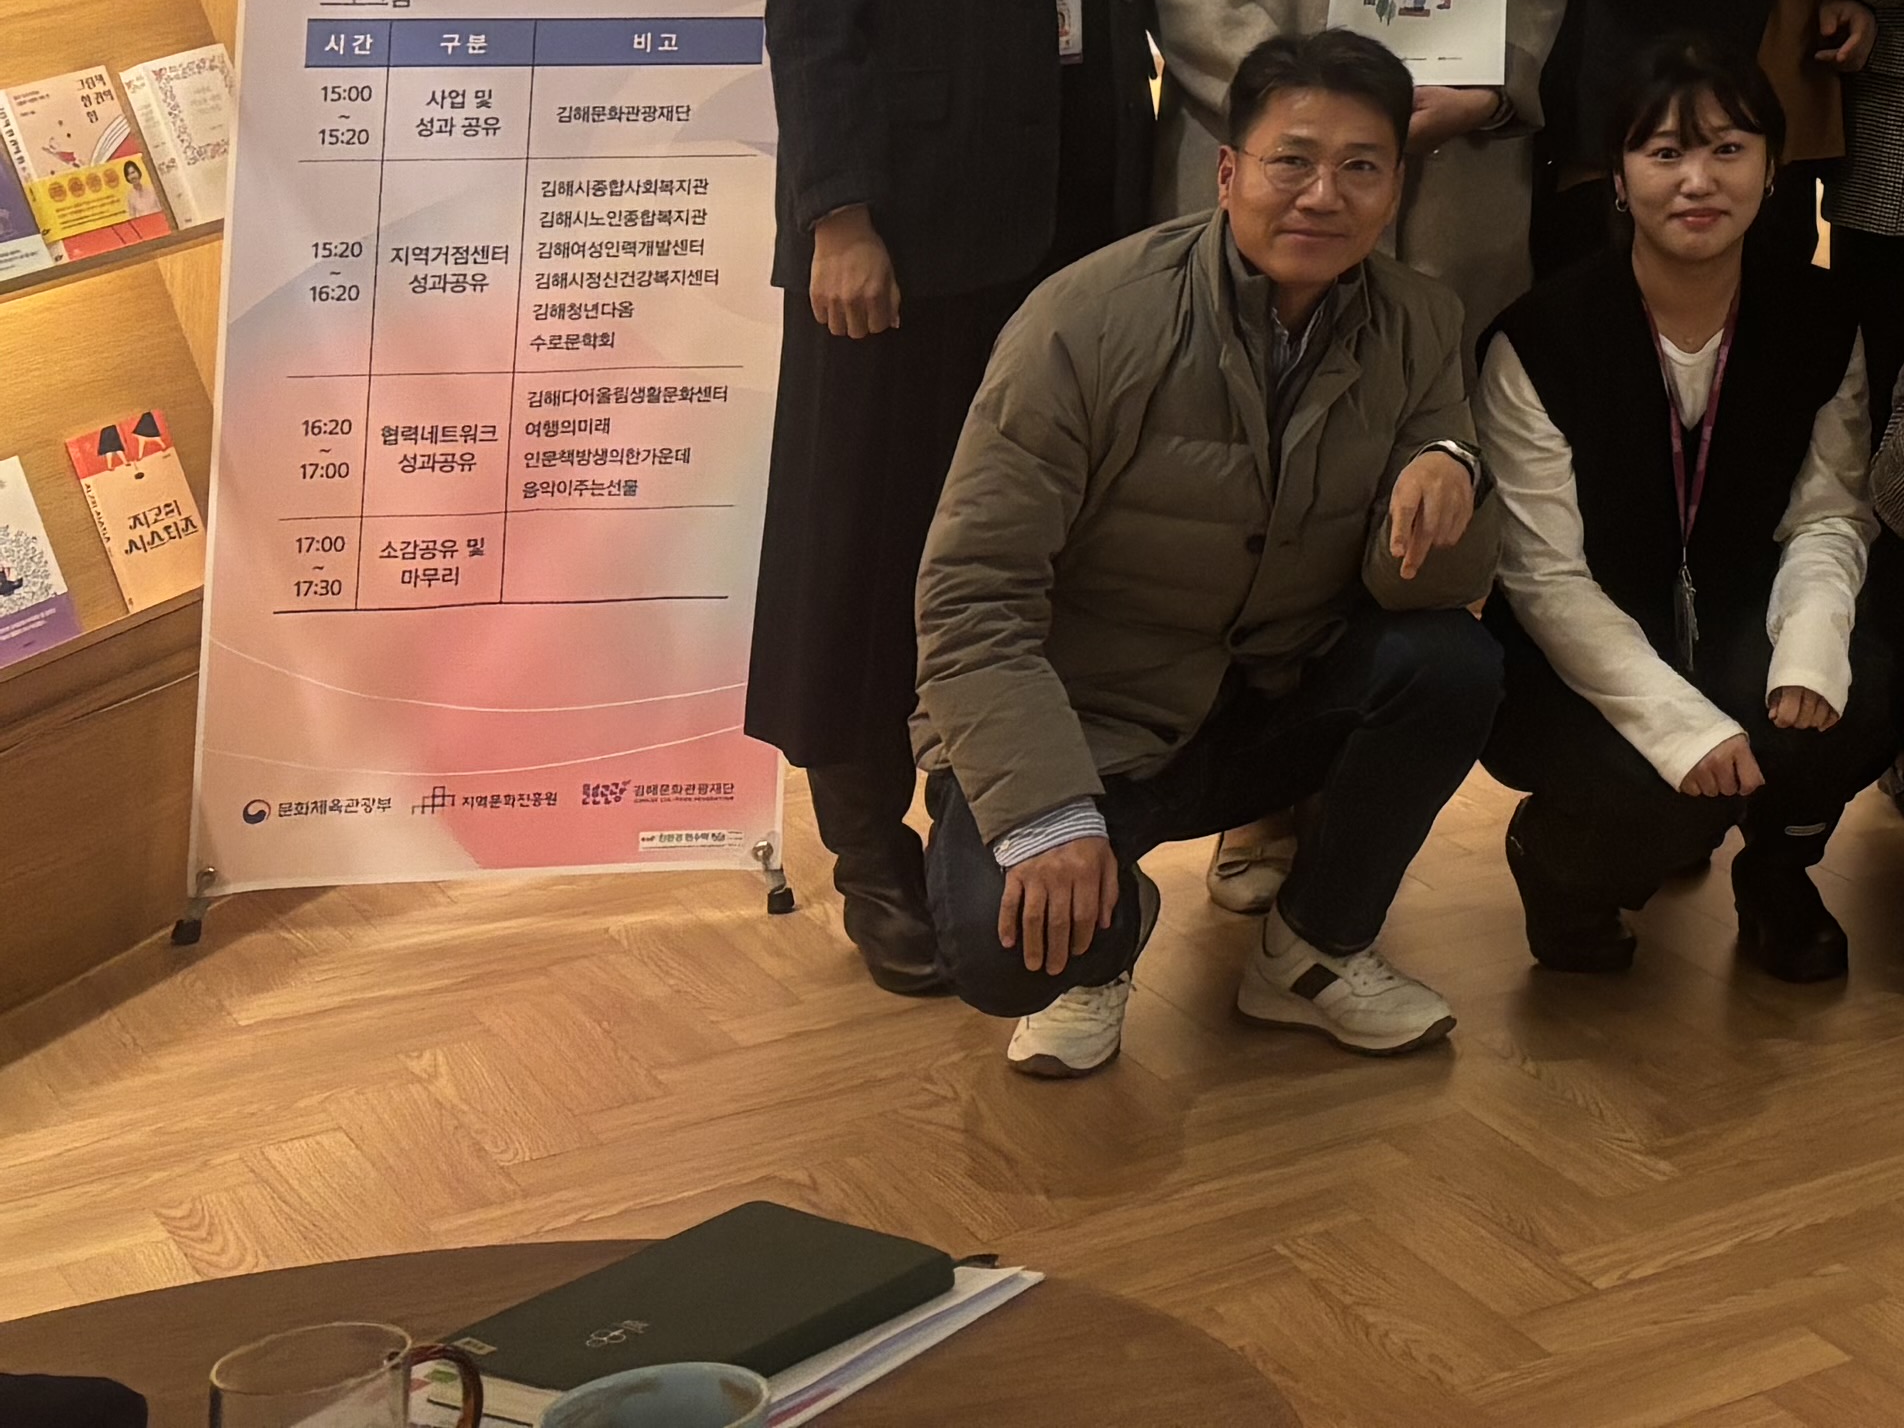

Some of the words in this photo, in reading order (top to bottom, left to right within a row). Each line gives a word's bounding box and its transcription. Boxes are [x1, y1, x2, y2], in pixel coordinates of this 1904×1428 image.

[320, 85, 373, 103] 15:00
[426, 89, 467, 109] 사업
[473, 89, 494, 109] 및
[556, 104, 691, 123] 김해문화관광재단
[318, 128, 370, 146] 15:20
[416, 117, 456, 138] 성과
[461, 116, 502, 137] 공유
[311, 241, 363, 259] 15:20
[390, 244, 510, 266] 지역거점센터
[536, 238, 706, 258] 김해여성인력개발센터
[409, 272, 490, 294] 성과공유
[309, 285, 360, 303] 16:20
[530, 331, 616, 351] 수로문학회
[301, 419, 352, 437] 16:20
[380, 424, 499, 446] 협력네트워크
[525, 417, 611, 438] 여행의미래
[299, 462, 350, 480] 17:00
[398, 452, 478, 474] 성과공유
[522, 478, 639, 498] 음악이주는선물
[296, 535, 346, 554] 17:00
[379, 539, 459, 560] 소감공유
[466, 537, 486, 558] 및
[400, 565, 460, 587] 마무리
[294, 579, 343, 598] 17:30
[278, 797, 392, 819] 문화체육관광부
